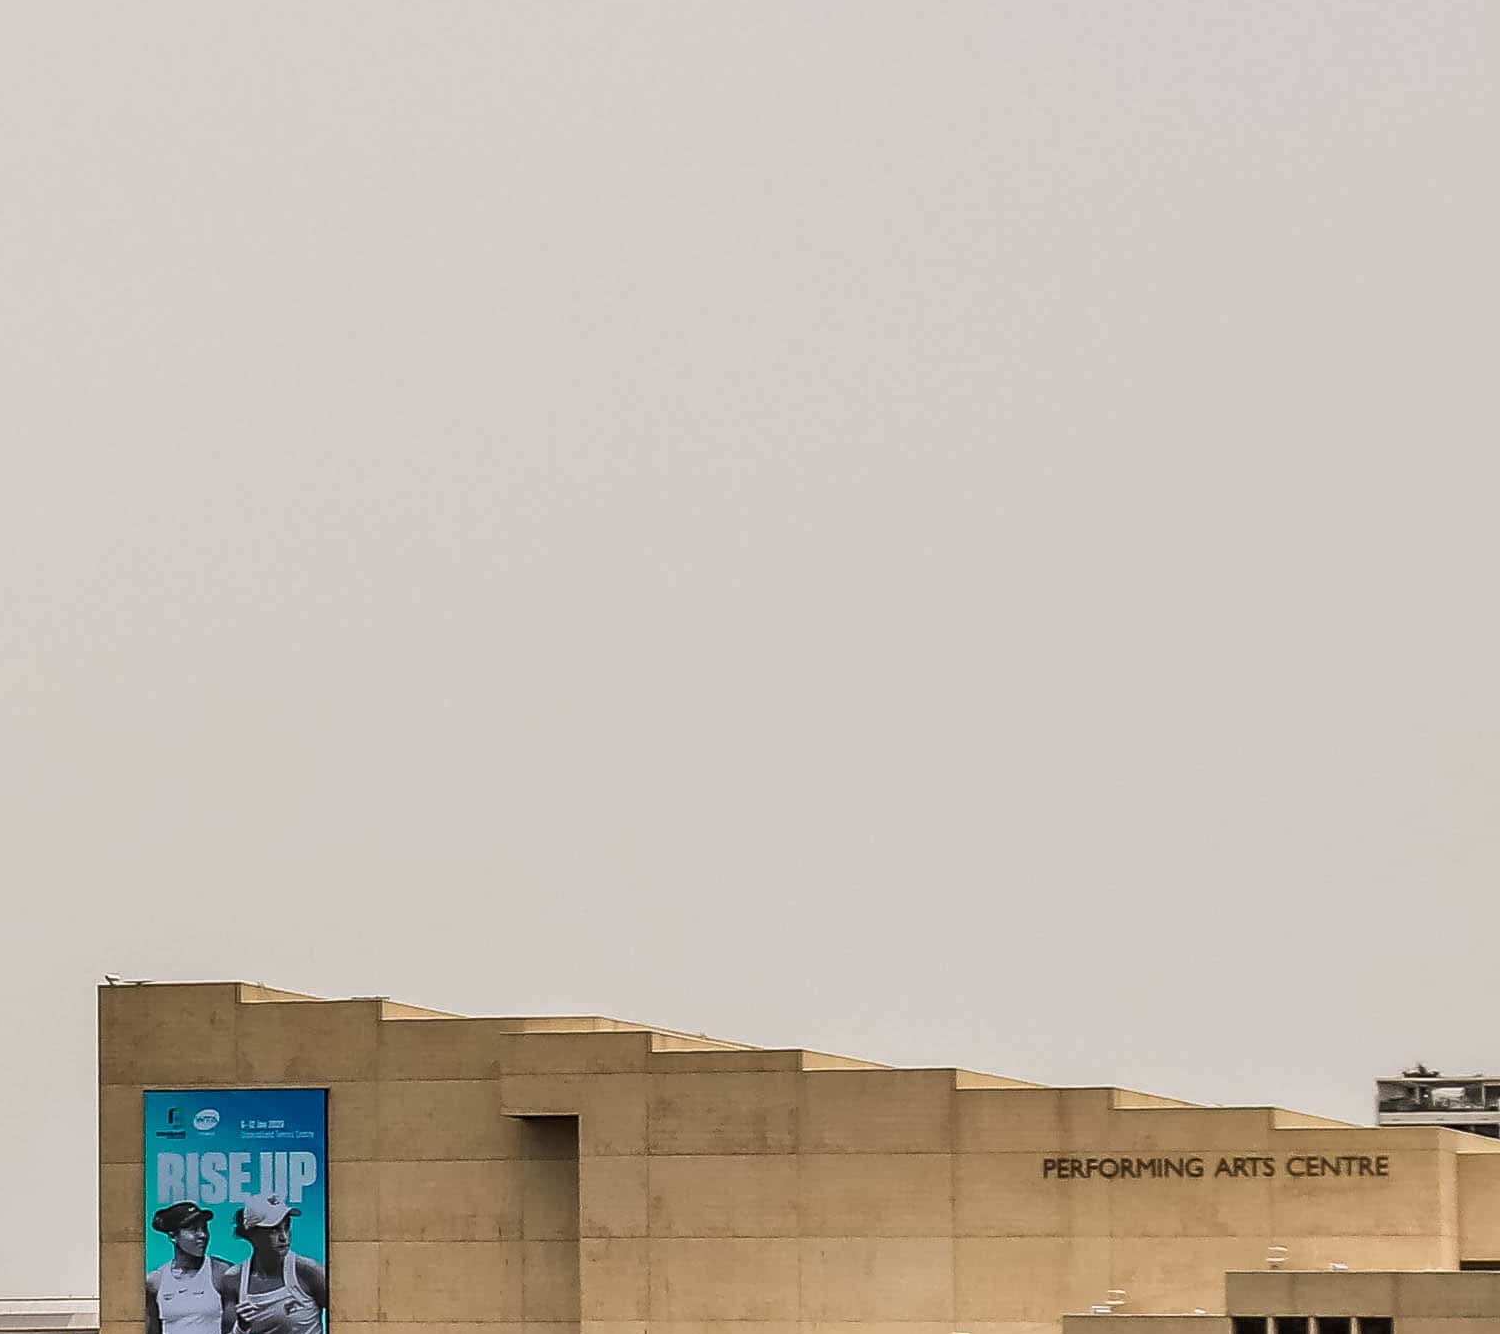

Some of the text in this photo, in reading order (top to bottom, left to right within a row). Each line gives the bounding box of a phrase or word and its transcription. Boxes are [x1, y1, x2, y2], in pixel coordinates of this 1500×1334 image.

[156, 1151, 318, 1204] RISE UP
[1043, 1155, 1389, 1179] PERFORMING ARTS CENTRE
